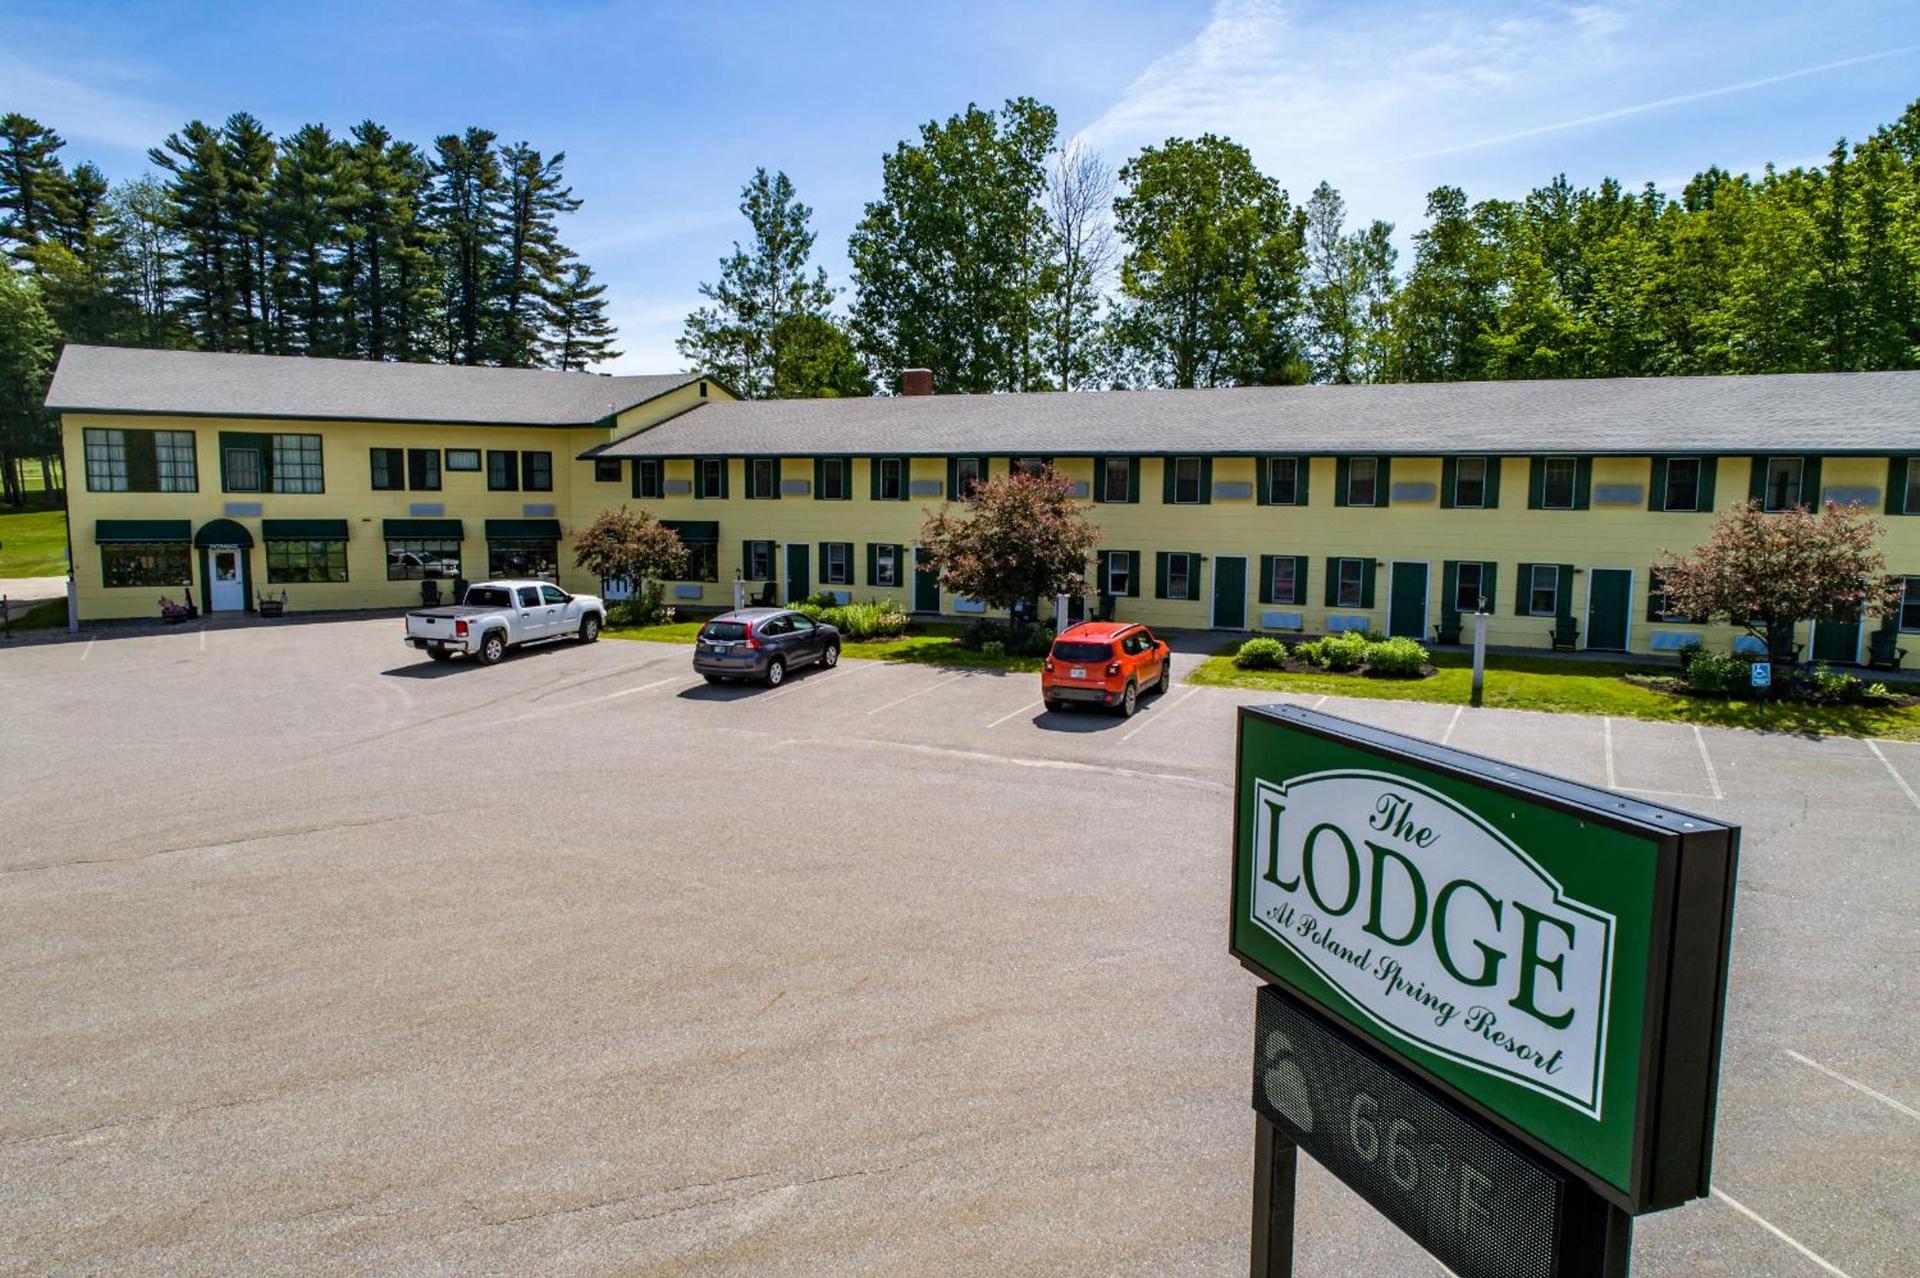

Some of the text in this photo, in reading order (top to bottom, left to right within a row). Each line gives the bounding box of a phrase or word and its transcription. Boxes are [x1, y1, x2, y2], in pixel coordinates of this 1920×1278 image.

[1369, 792, 1440, 848] The
[1263, 798, 1576, 1030] LODGE
[1267, 902, 1565, 1075] At Poland Spring Resort
